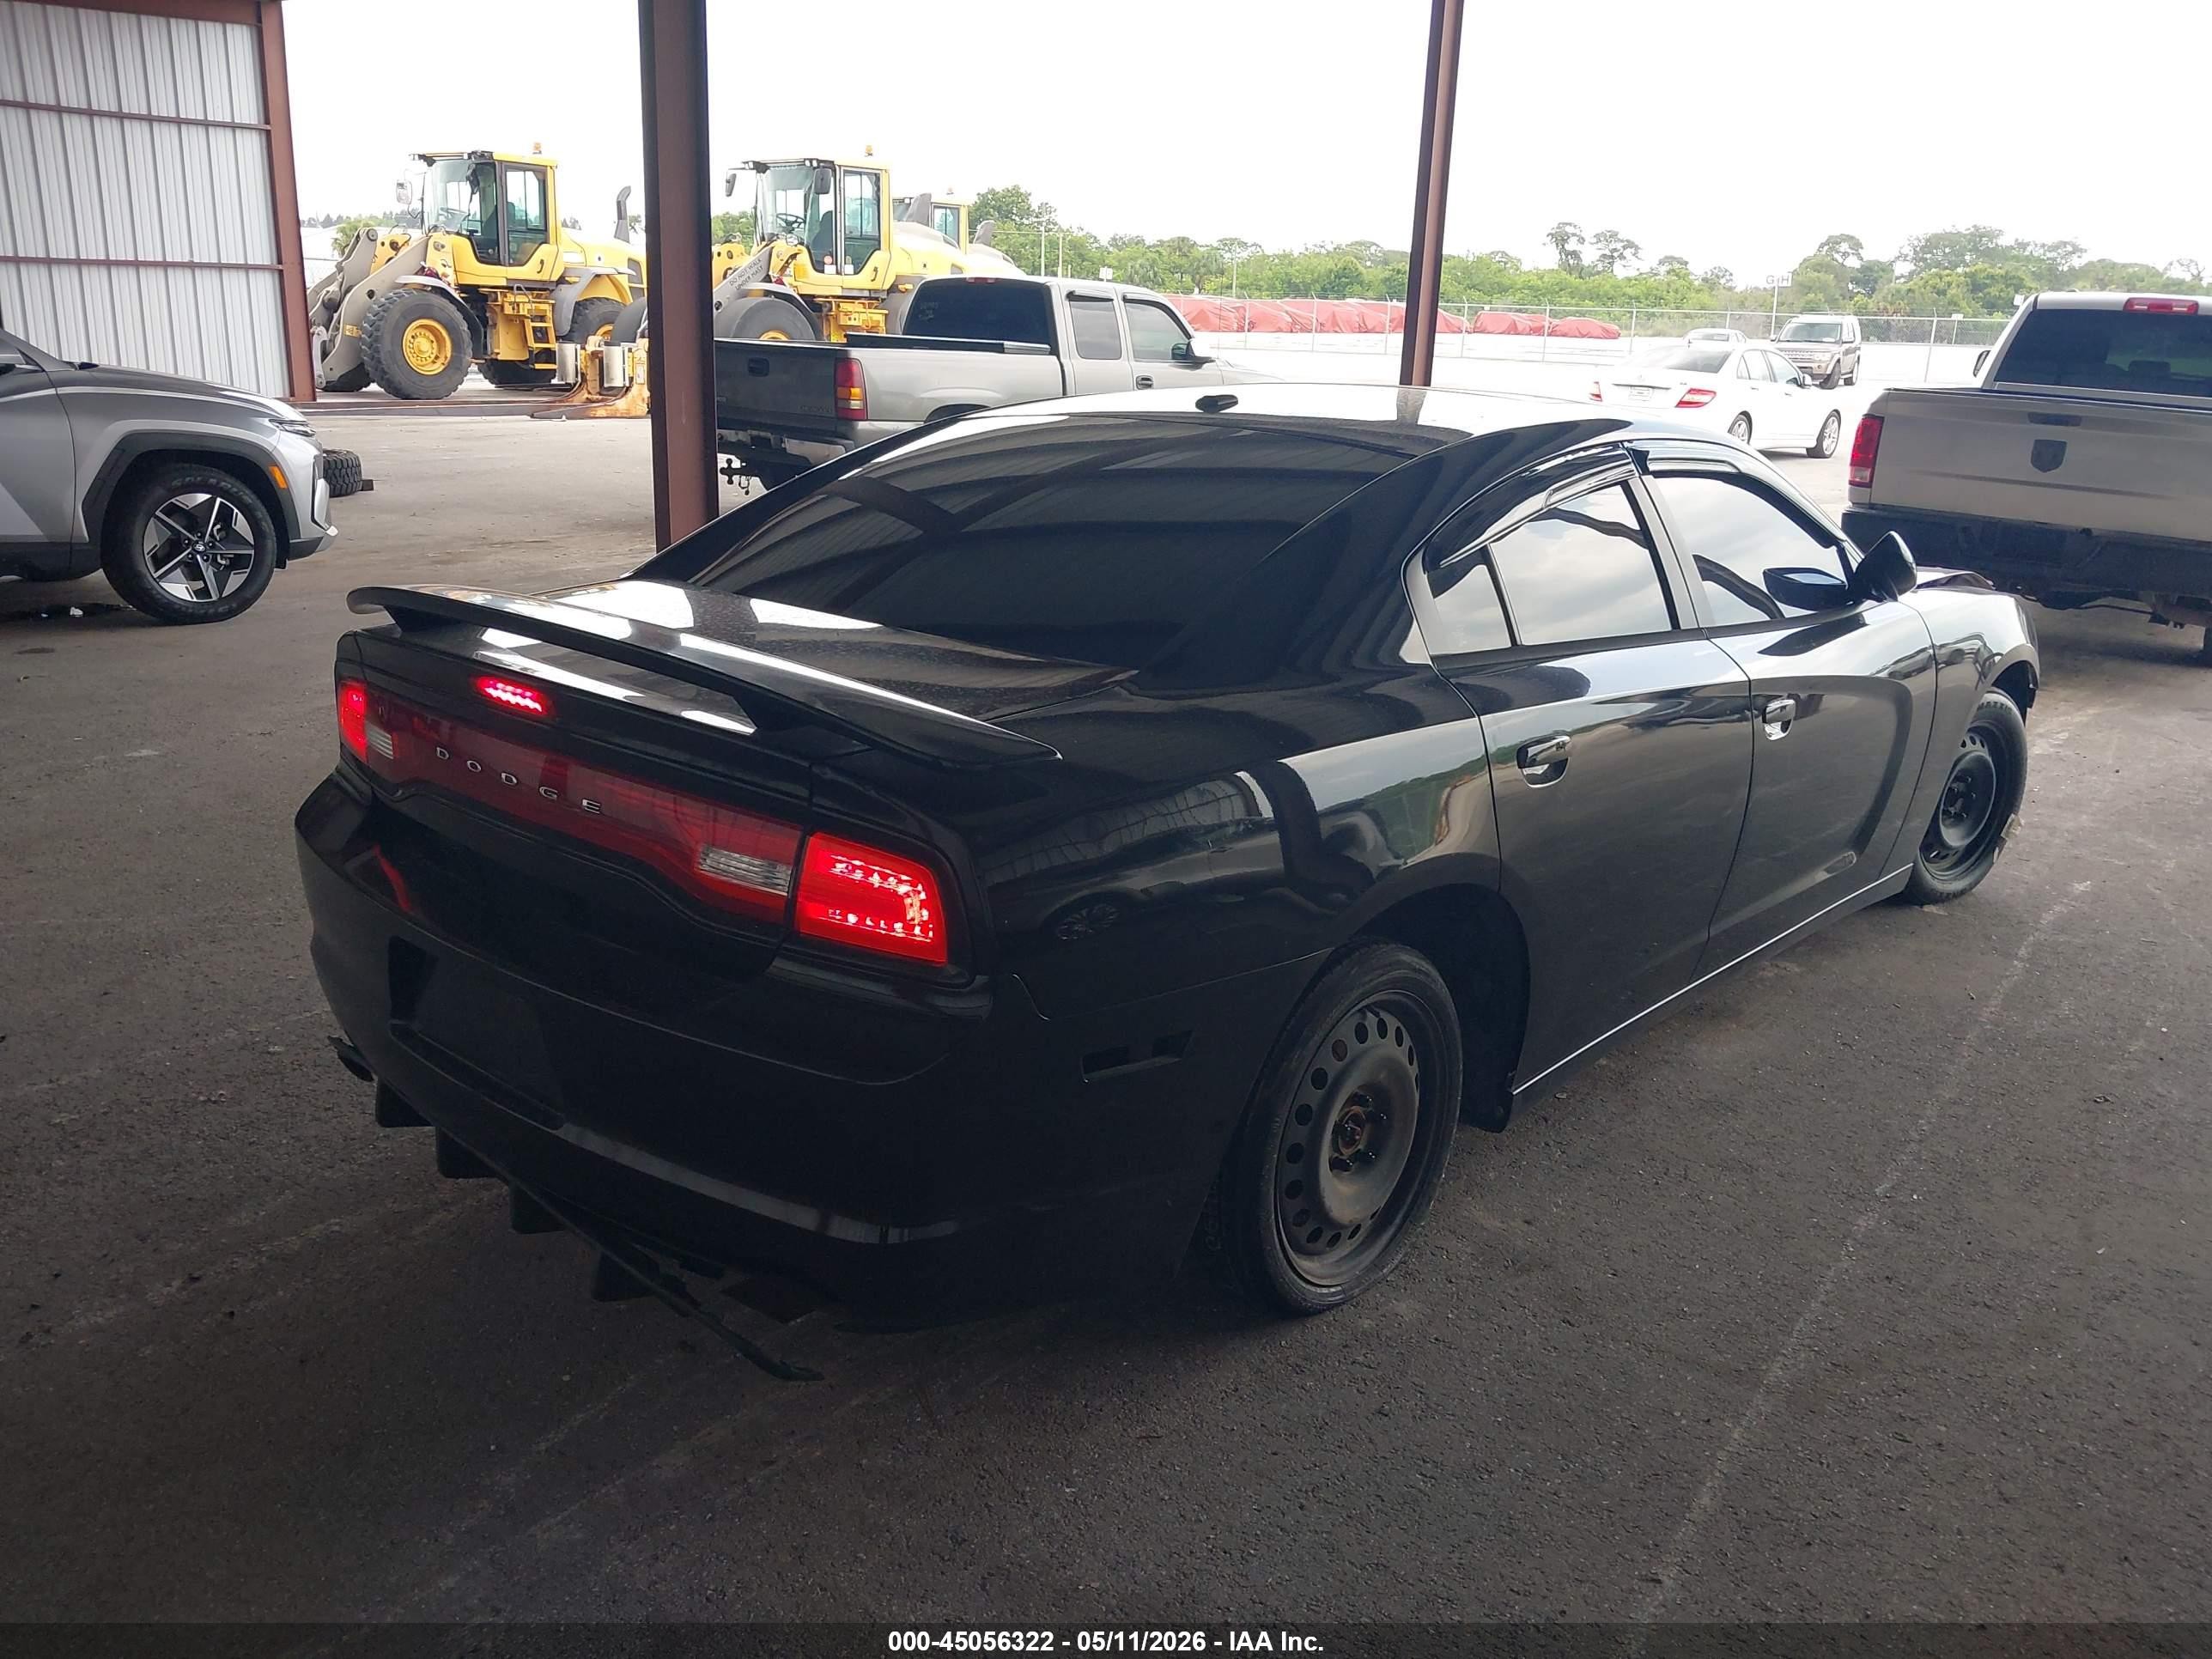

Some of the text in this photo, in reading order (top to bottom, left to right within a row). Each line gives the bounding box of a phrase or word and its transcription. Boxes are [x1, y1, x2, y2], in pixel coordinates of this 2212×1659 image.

[738, 268, 748, 280] NOT
[748, 258, 762, 270] WALK
[735, 276, 750, 289] UNDER
[1765, 274, 1790, 285] G H
[436, 746, 601, 814] DODGE
